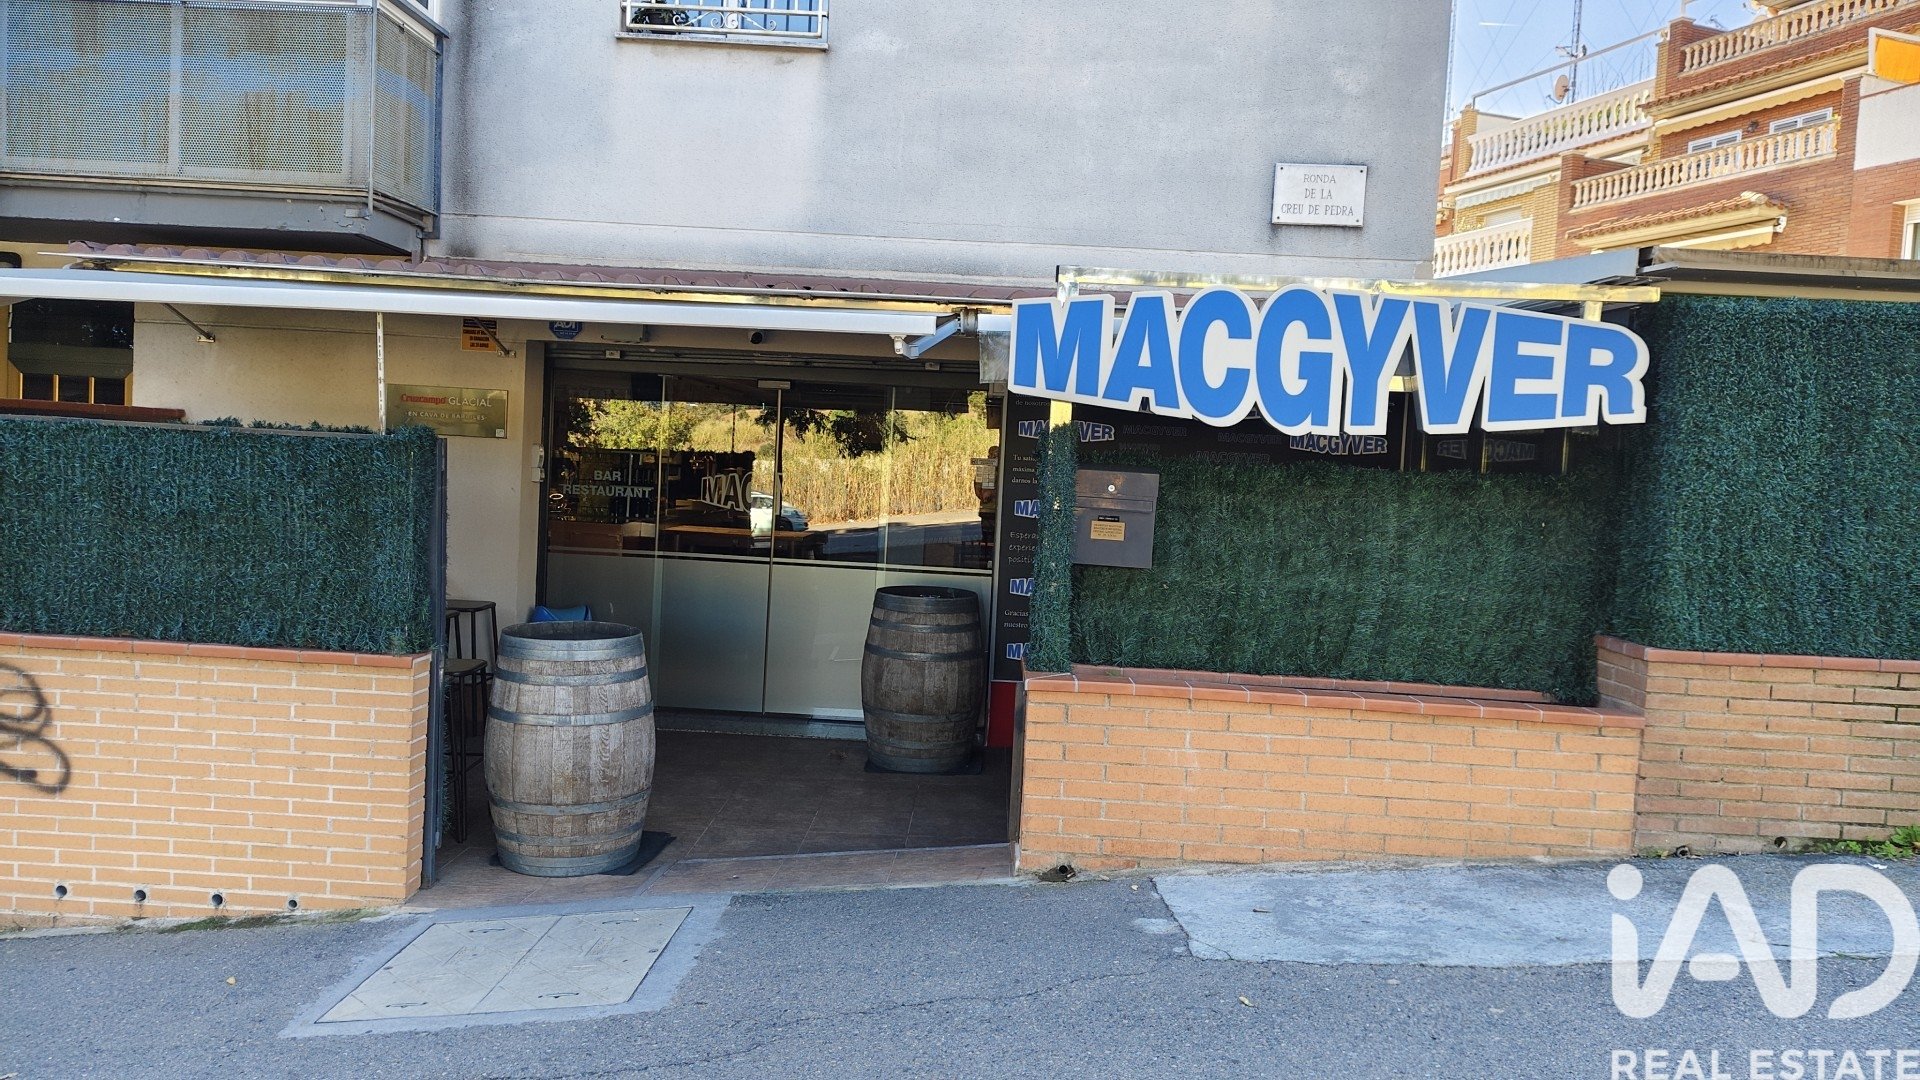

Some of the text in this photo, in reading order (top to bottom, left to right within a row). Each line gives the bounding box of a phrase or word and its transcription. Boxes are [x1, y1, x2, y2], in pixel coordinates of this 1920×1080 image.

[1303, 174, 1336, 184] RONDA
[1304, 188, 1333, 200] DE LA
[1281, 203, 1354, 216] CREU DE PEDRA
[1008, 284, 1649, 435] MACGYVER
[448, 396, 492, 407] GLACIAL
[1289, 432, 1388, 455] MACGYVER
[593, 470, 622, 482] BAR
[561, 484, 653, 499] RESTAURANT
